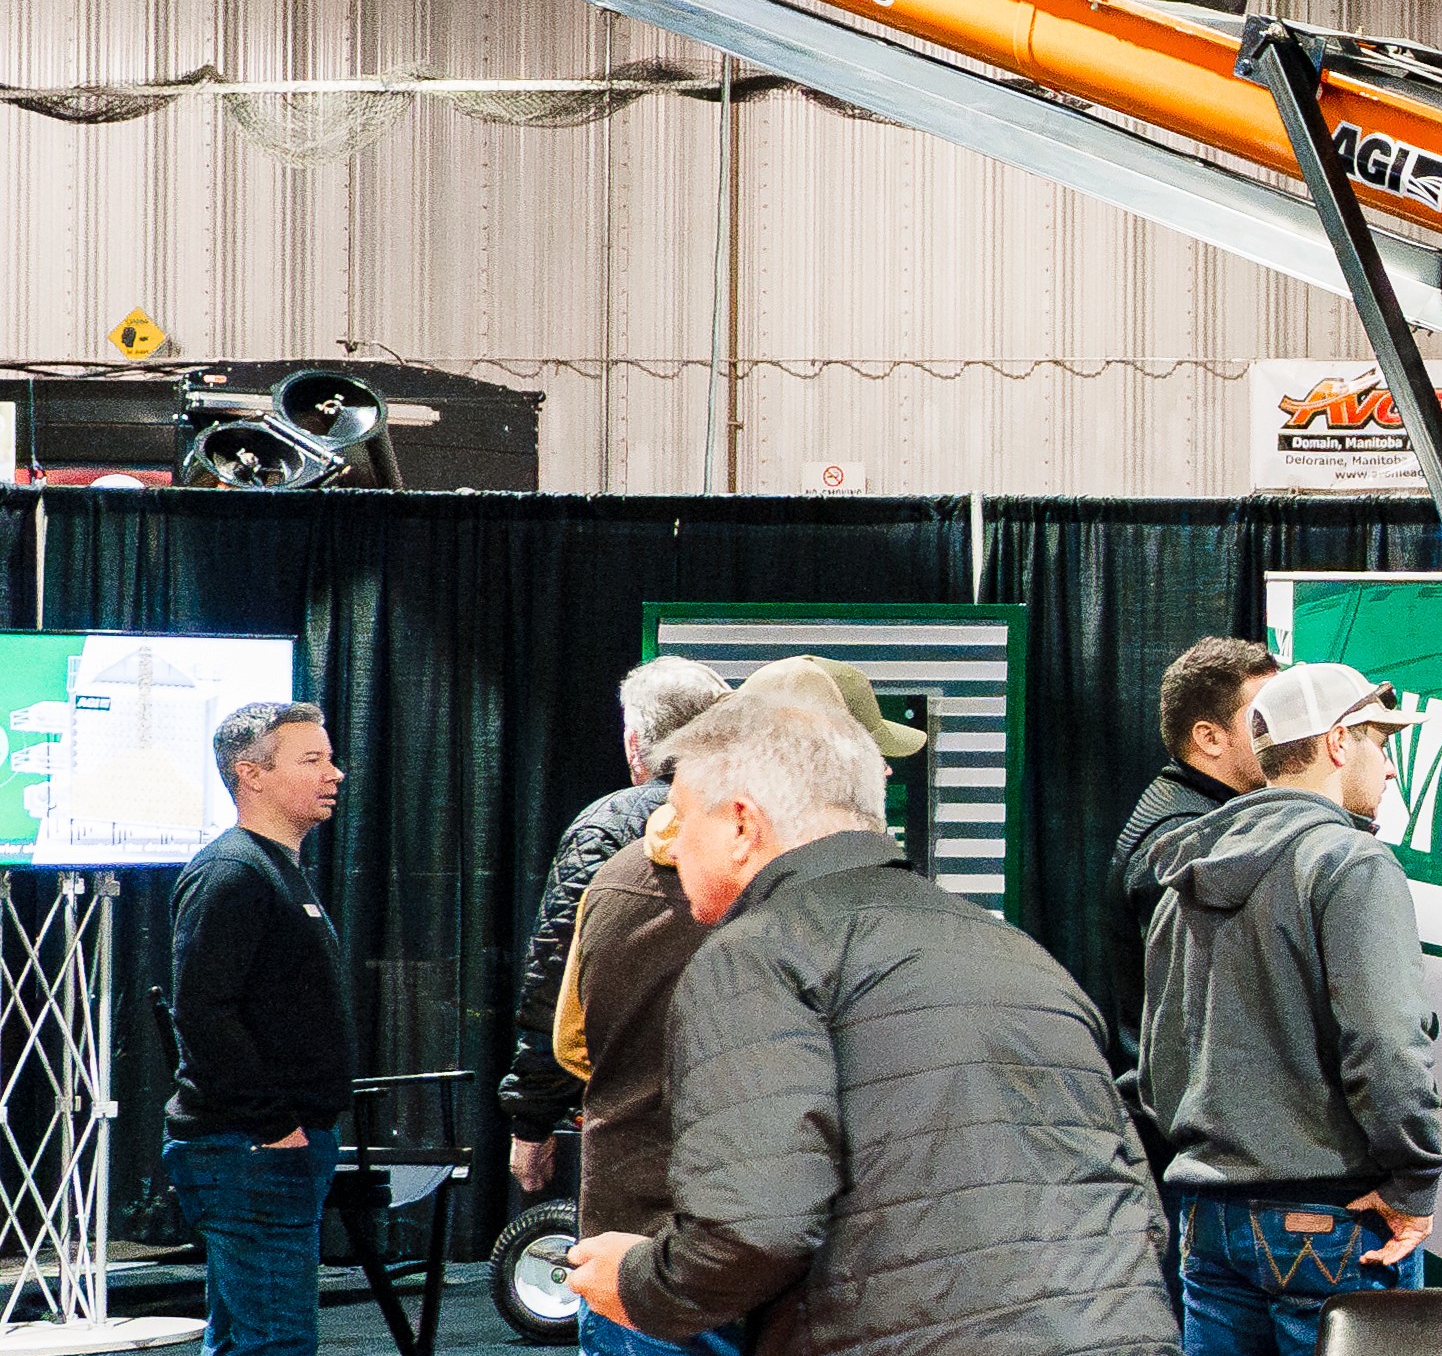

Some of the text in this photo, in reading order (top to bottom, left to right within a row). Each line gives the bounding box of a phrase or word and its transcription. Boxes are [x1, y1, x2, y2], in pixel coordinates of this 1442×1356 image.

[1331, 122, 1410, 194] AGI
[1292, 436, 1342, 451] Domain,
[1345, 436, 1403, 450] Manitoba
